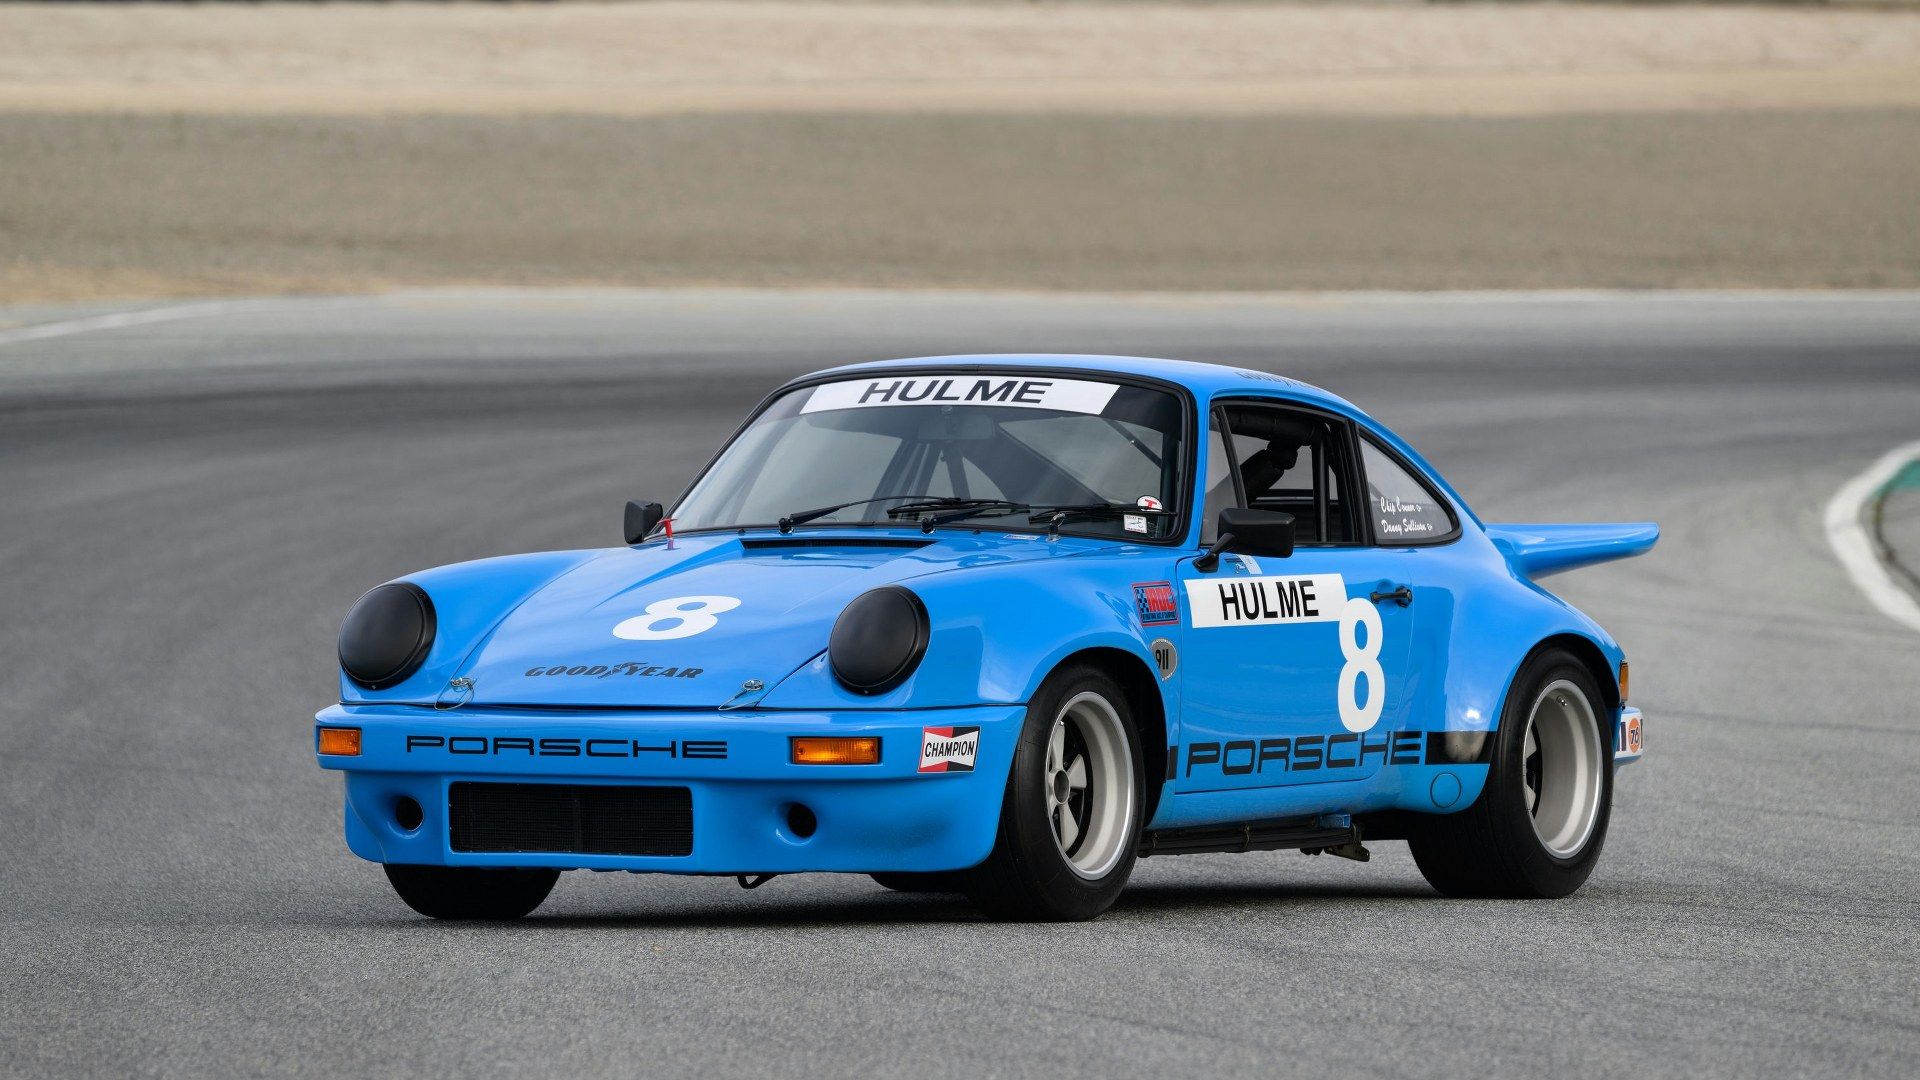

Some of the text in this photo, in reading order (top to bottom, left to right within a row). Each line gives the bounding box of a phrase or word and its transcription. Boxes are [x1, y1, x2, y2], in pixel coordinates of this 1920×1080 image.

[858, 380, 1053, 403] HULME
[1218, 580, 1319, 620] HULME
[612, 596, 742, 641] 8
[525, 661, 704, 679] GOODYEAR
[1155, 649, 1169, 670] 911
[1338, 597, 1385, 733] 8
[406, 735, 728, 759] PORSCHE
[1630, 726, 1640, 745] 76
[924, 741, 975, 758] CHAMPION
[1186, 731, 1422, 778] PORSCHE
